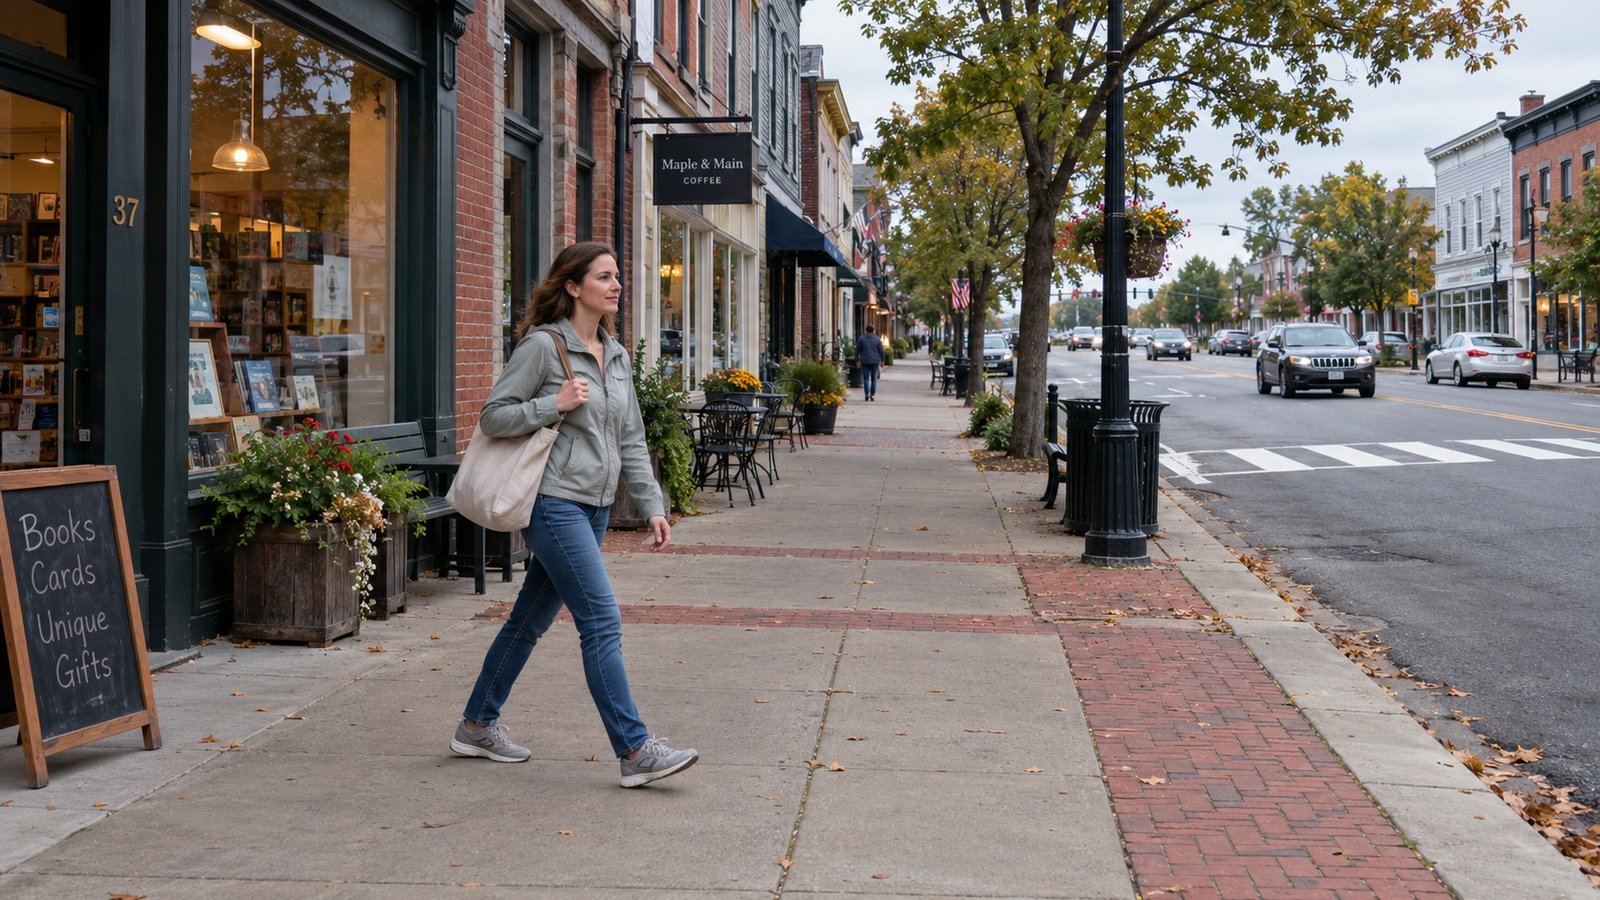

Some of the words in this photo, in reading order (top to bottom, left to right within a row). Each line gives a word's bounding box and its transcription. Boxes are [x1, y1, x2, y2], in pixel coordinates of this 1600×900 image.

[662, 158, 698, 173] Maple
[700, 158, 710, 169] &
[714, 158, 744, 169] Main
[683, 177, 722, 185] COFFEE
[113, 195, 139, 227] 37
[19, 508, 96, 552] Books
[31, 554, 96, 595] Cards
[37, 609, 110, 647] Unique
[55, 649, 112, 689] Gifts
